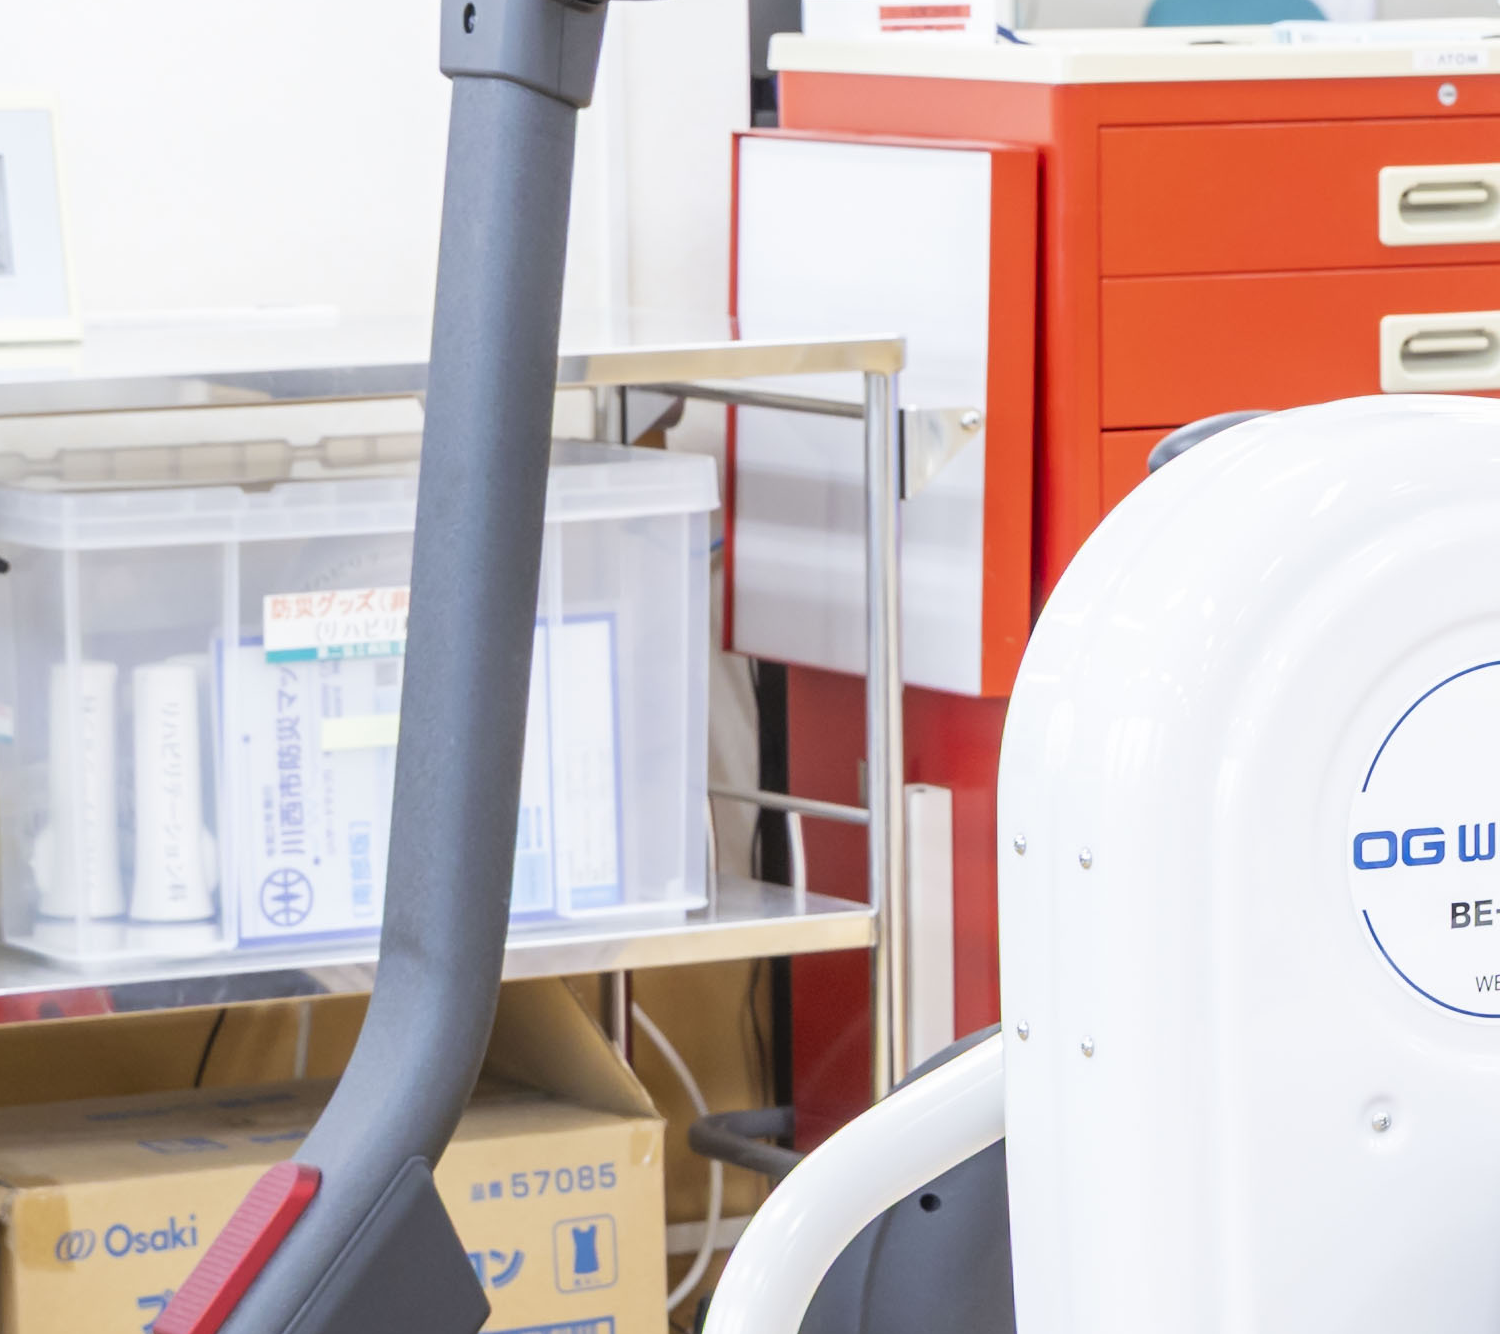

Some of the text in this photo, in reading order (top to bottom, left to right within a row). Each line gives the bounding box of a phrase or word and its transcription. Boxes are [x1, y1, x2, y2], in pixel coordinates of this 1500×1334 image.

[1353, 825, 1446, 871] OG
[510, 1161, 618, 1200] 57085
[103, 1213, 199, 1259] Osaki
